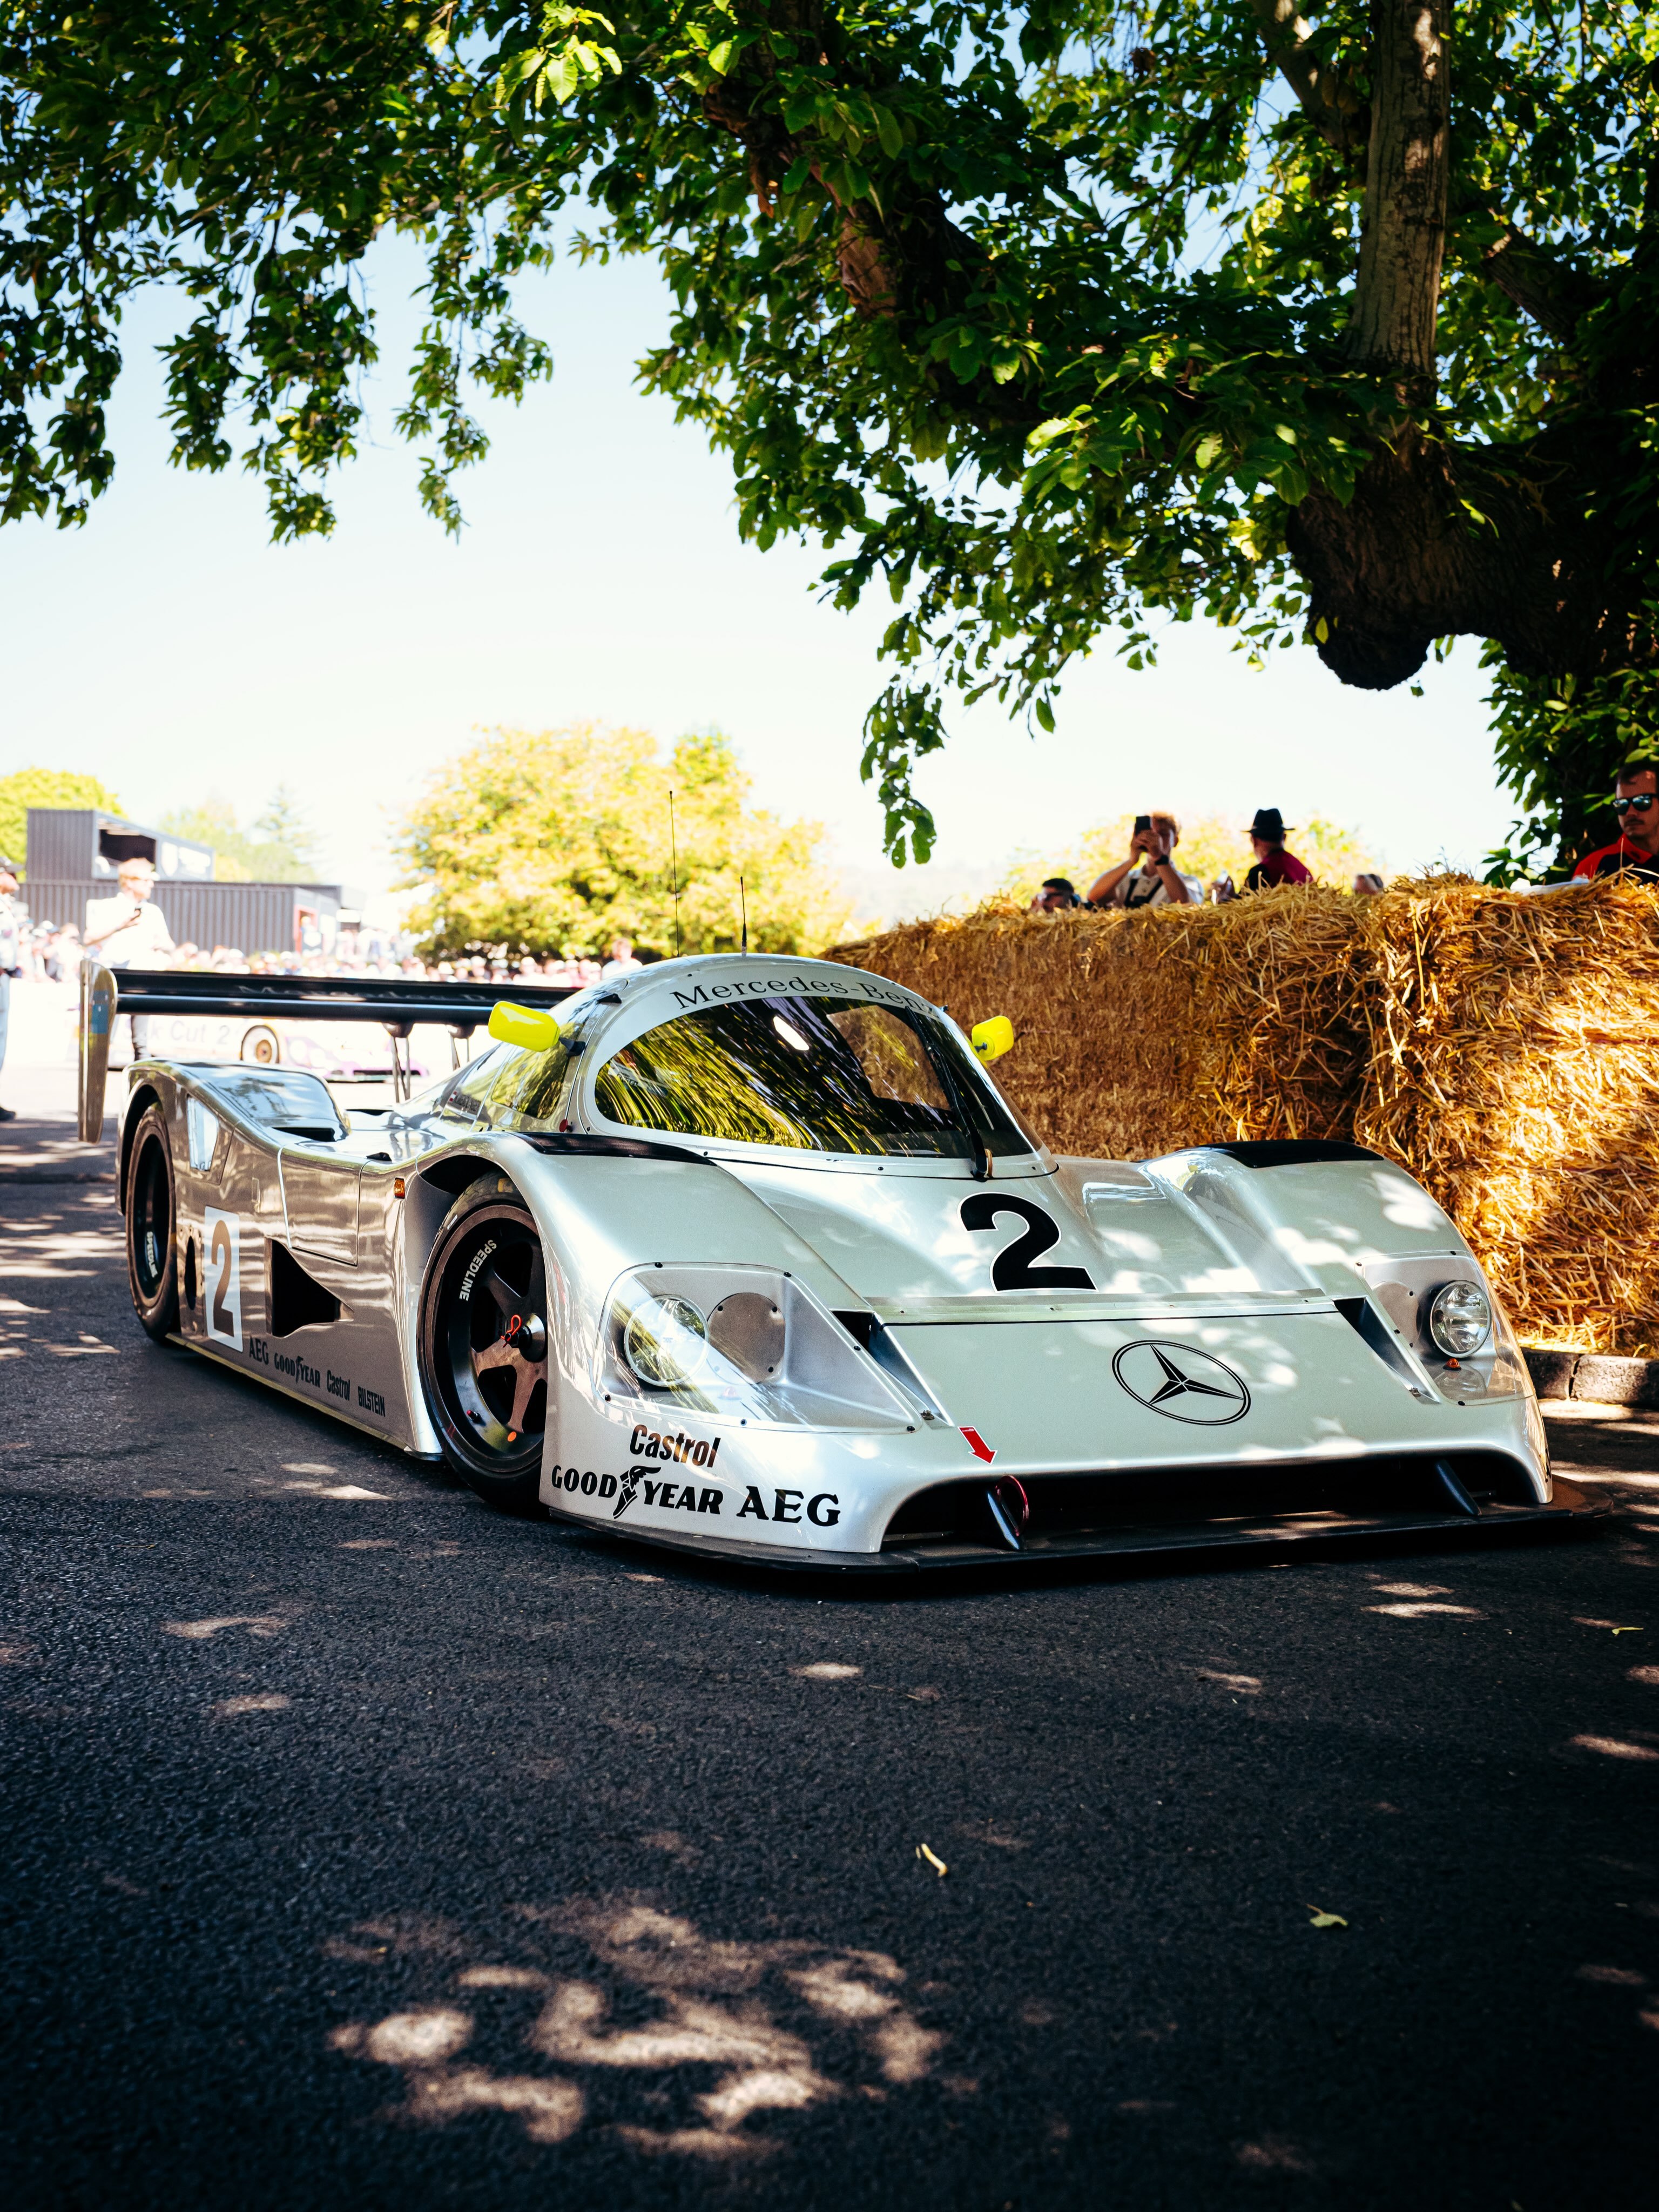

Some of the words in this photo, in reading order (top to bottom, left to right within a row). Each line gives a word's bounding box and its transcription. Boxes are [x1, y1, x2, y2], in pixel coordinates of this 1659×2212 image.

[459, 1239, 497, 1301] SPEEDLINE
[958, 1192, 1099, 1292] 2
[211, 1219, 234, 1338] 2
[249, 1336, 269, 1365] AEG
[327, 1369, 350, 1401] Castrol
[357, 1386, 386, 1418] BILSTEIN
[629, 1424, 721, 1468] Castrol
[736, 1485, 841, 1527] AEG
